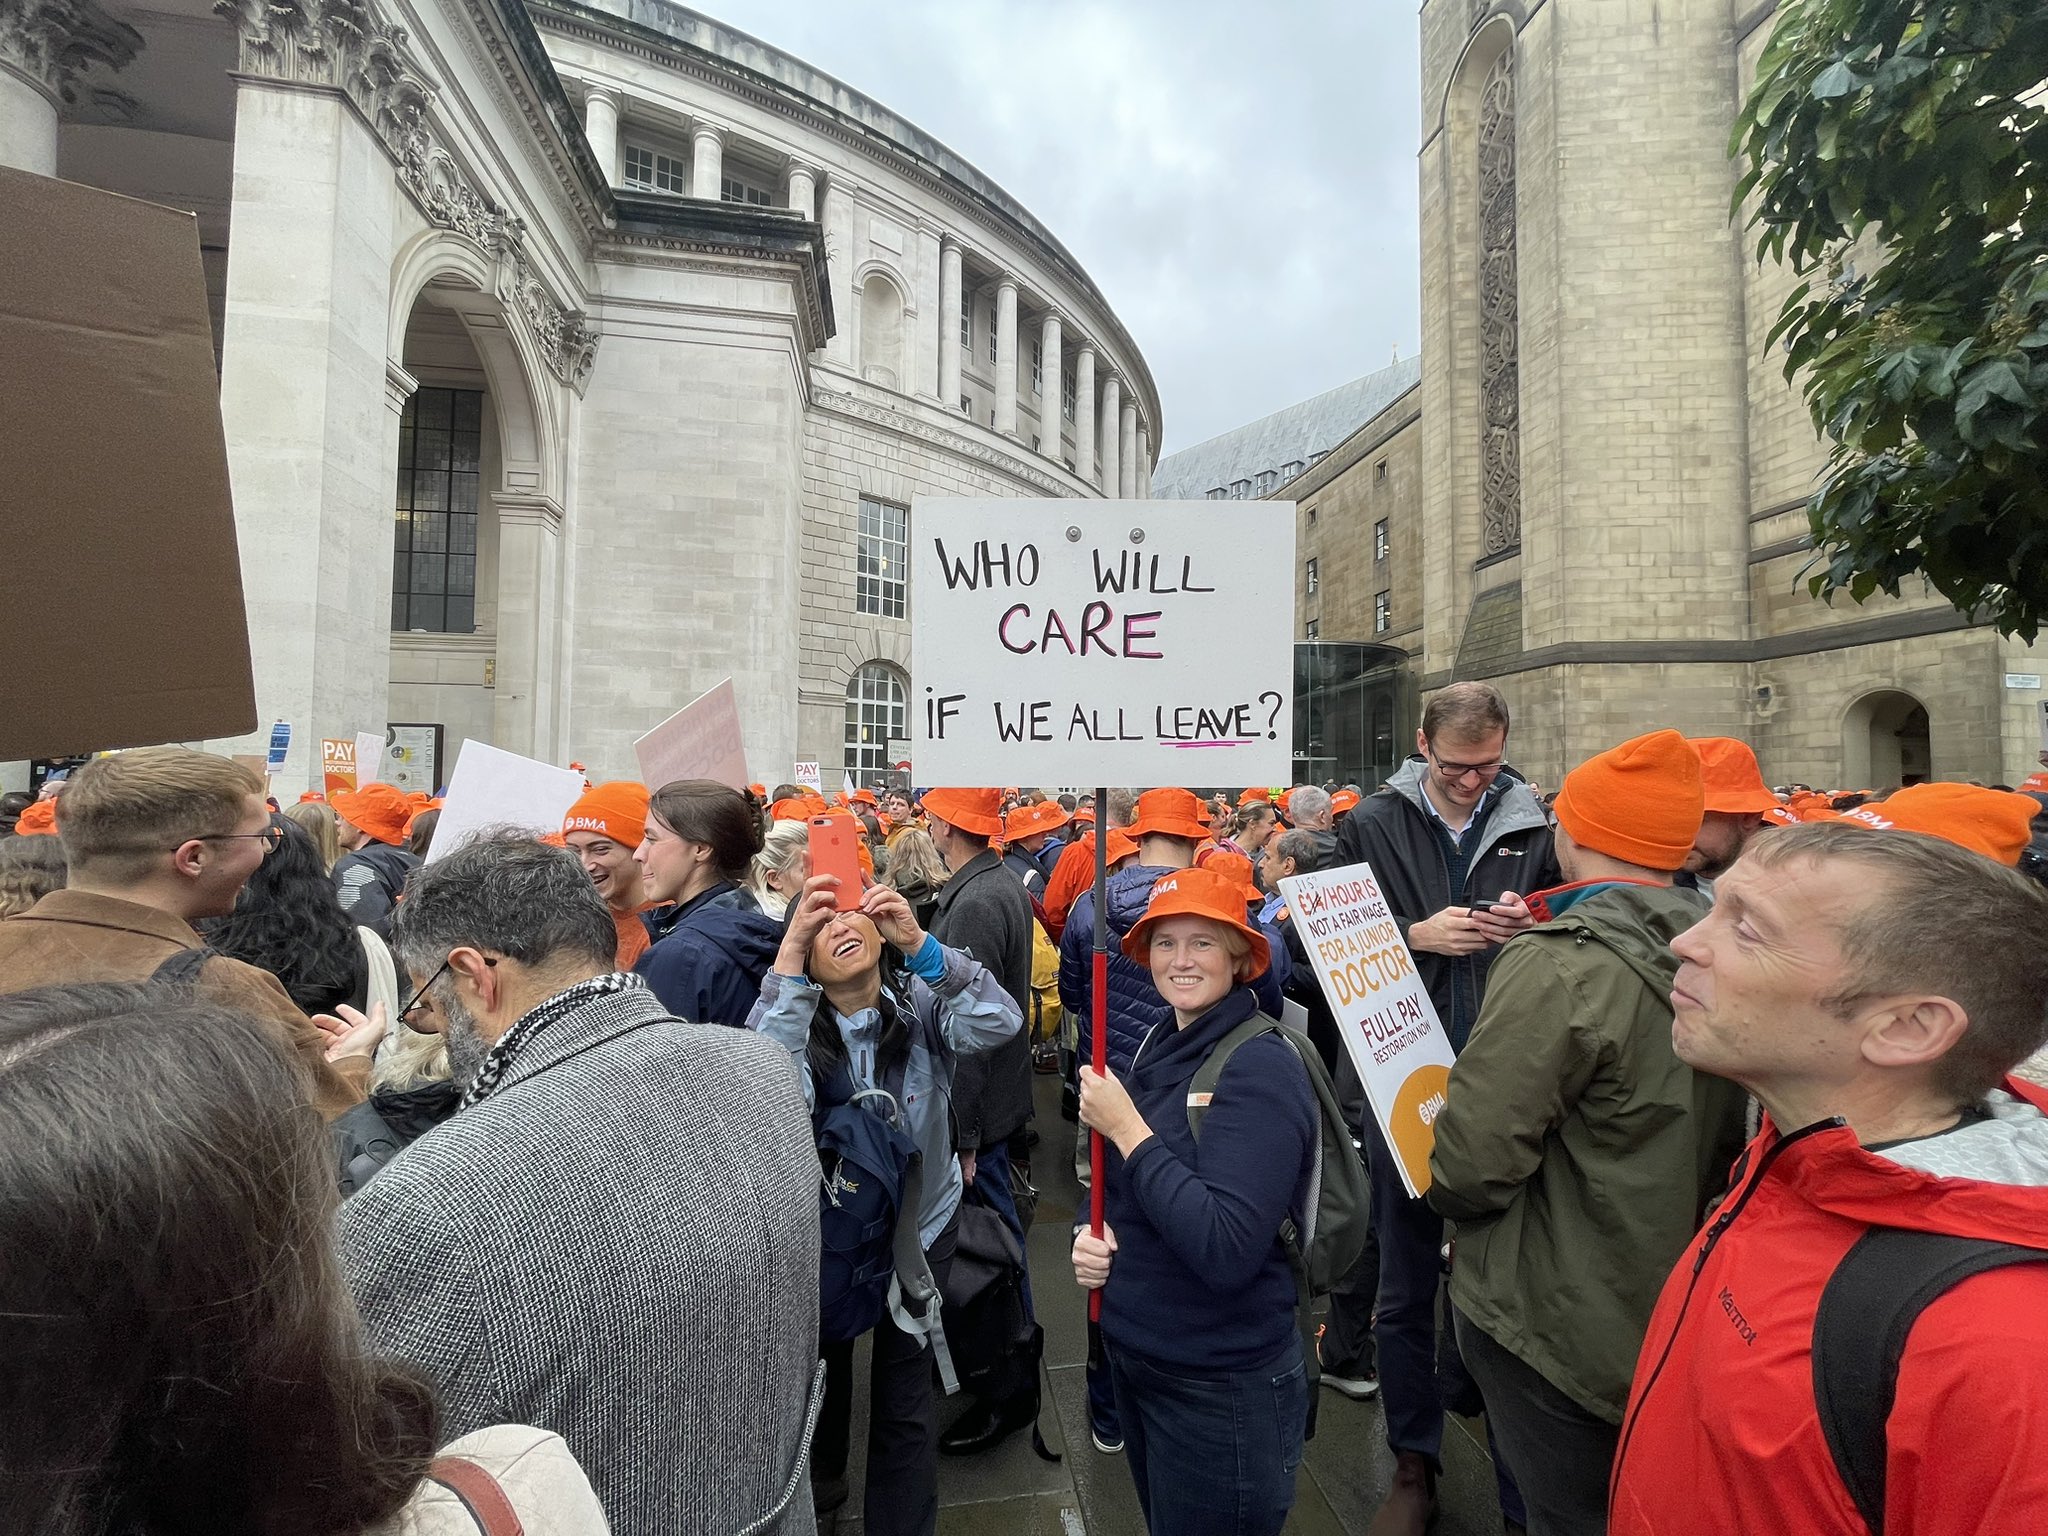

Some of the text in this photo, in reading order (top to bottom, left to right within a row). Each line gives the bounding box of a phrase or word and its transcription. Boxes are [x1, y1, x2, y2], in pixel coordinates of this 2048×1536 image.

[934, 538, 1215, 594] WHO WILL
[998, 600, 1165, 659] CARE
[994, 701, 1053, 742] WE
[1068, 703, 1144, 741] ALL
[1156, 690, 1283, 743] LEAVE?
[323, 740, 354, 761] PAY
[325, 764, 355, 774] DOCTORS
[795, 763, 818, 776] PAY
[575, 817, 606, 832] BMA
[1785, 812, 1802, 824] BM
[1361, 878, 1377, 899] IS
[1308, 901, 1387, 939] NOT A FAIR WAGE
[1317, 921, 1398, 966] FOR A JUNIOR
[1329, 944, 1414, 1007] DOCTOR
[1359, 992, 1424, 1049] FULL PAY
[1373, 1019, 1432, 1066] RESTORATION NOW
[1425, 1091, 1445, 1119] BMA
[1718, 1285, 1757, 1348] Marmot
